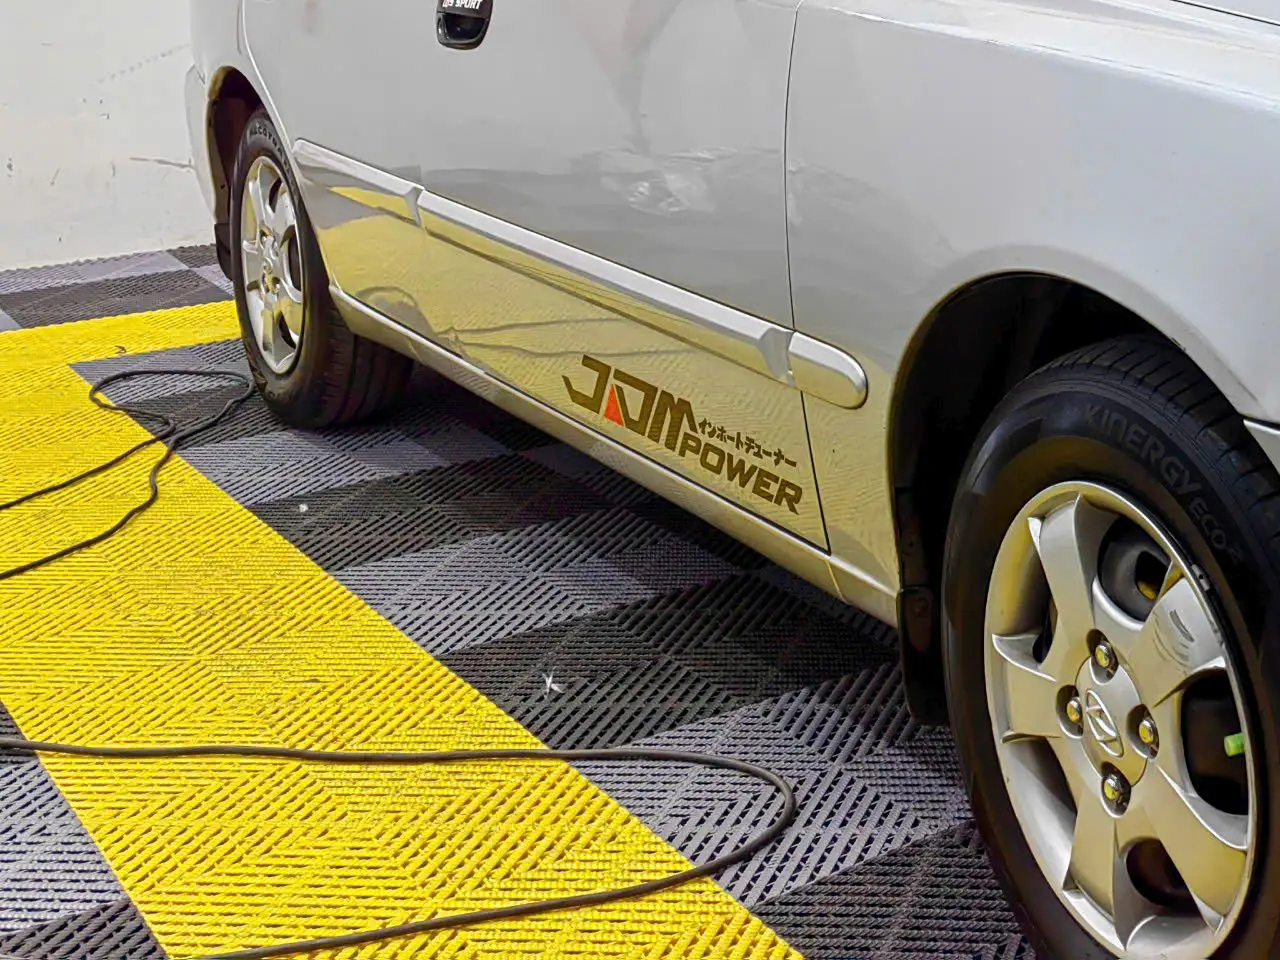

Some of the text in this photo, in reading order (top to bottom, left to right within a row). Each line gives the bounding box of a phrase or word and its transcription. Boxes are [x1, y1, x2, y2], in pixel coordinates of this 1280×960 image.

[562, 354, 698, 452] JDM
[678, 431, 803, 515] POWER
[1083, 404, 1200, 494] KINERGY
